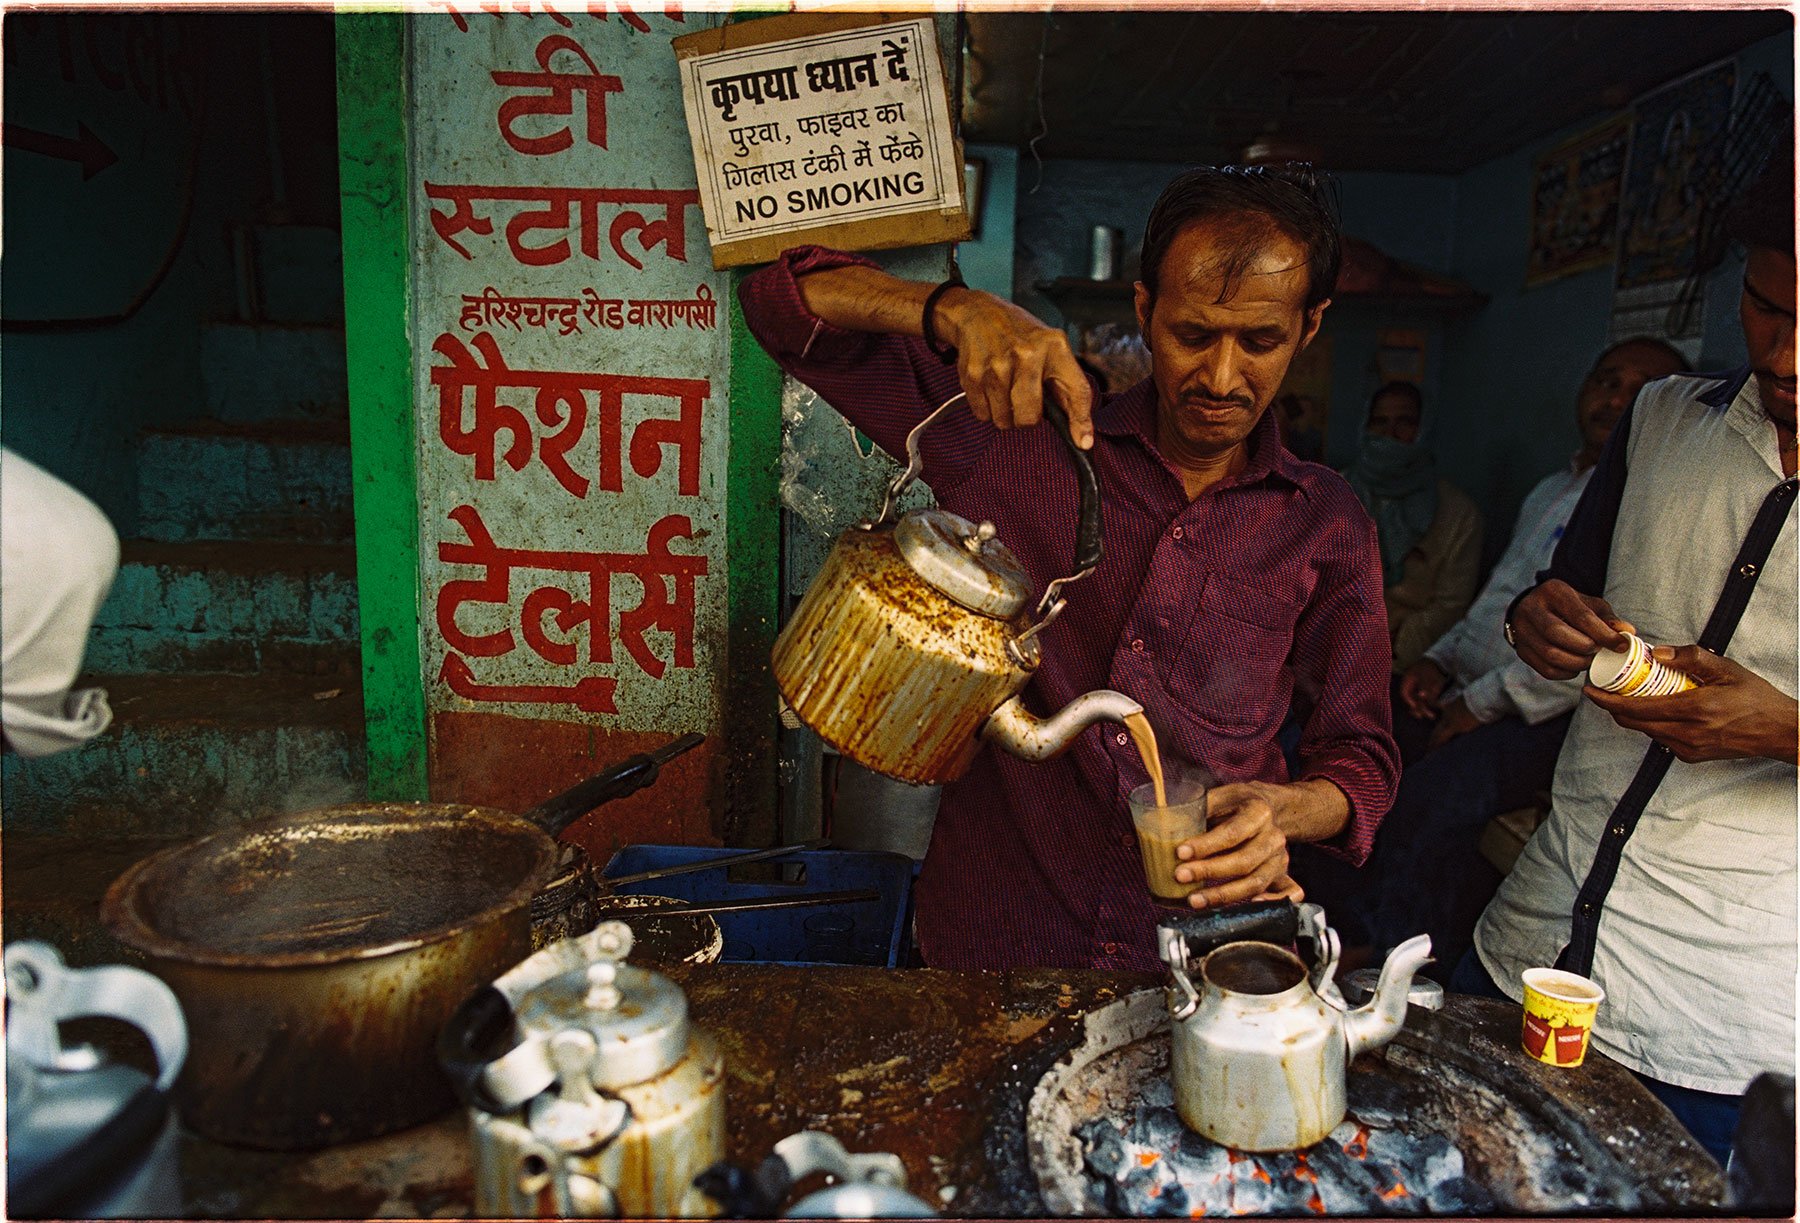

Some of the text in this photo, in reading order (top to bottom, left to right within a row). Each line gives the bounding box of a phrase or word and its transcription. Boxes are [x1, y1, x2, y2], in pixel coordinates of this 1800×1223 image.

[490, 34, 624, 156] टी
[706, 36, 910, 121] कृपया ध्यान दें
[722, 131, 924, 190] गिलास टंकी में फेंके
[729, 102, 906, 158] पुरवा, फाइवर का
[424, 180, 698, 270] स्टाल
[735, 171, 925, 223] NO SMOKING
[459, 283, 717, 336] हरिश्चन्द्र रोड वाराणसी
[430, 331, 711, 499] फैशन
[436, 504, 708, 680] टेलर्स
